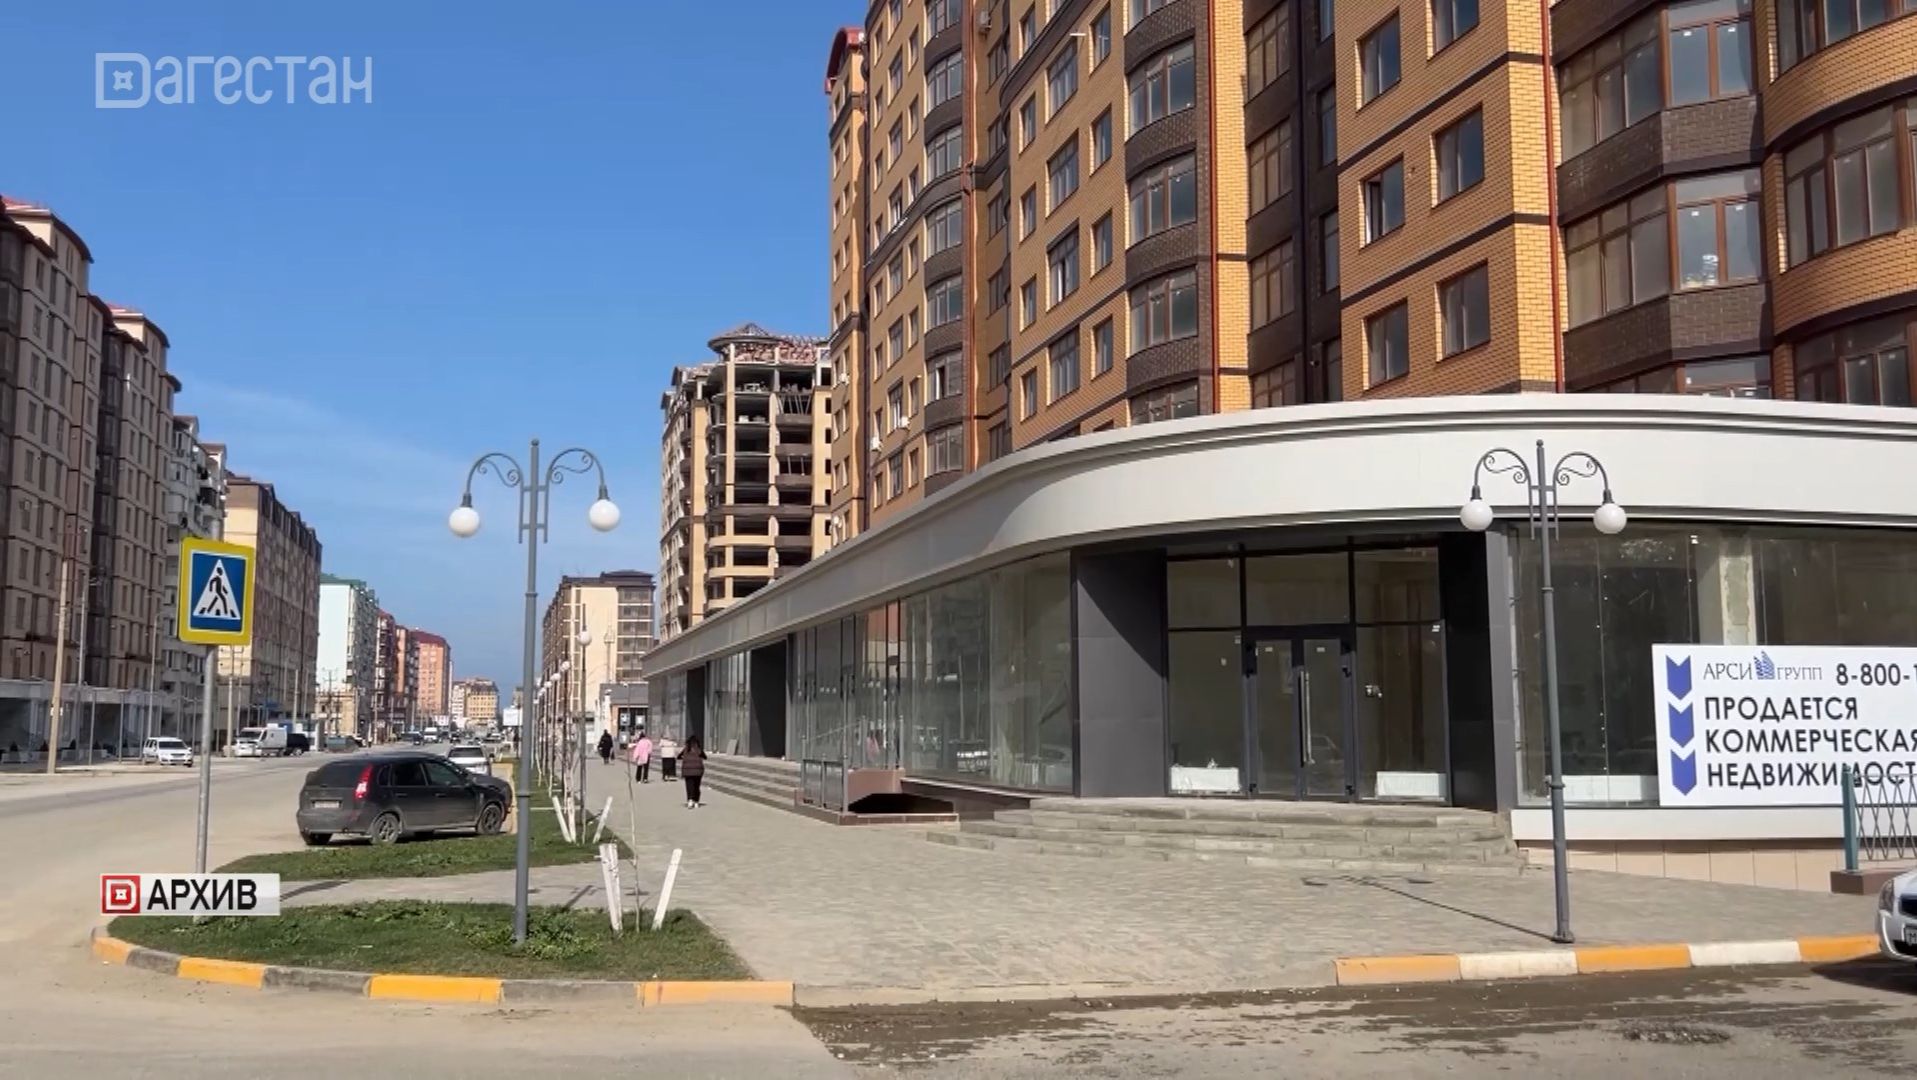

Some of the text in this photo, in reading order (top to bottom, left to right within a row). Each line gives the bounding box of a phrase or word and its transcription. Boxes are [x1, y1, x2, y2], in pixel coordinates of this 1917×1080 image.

[1703, 662, 1823, 681] АРСИ ГРУПП
[1704, 696, 1858, 723] ПРОДАЕТСЯ
